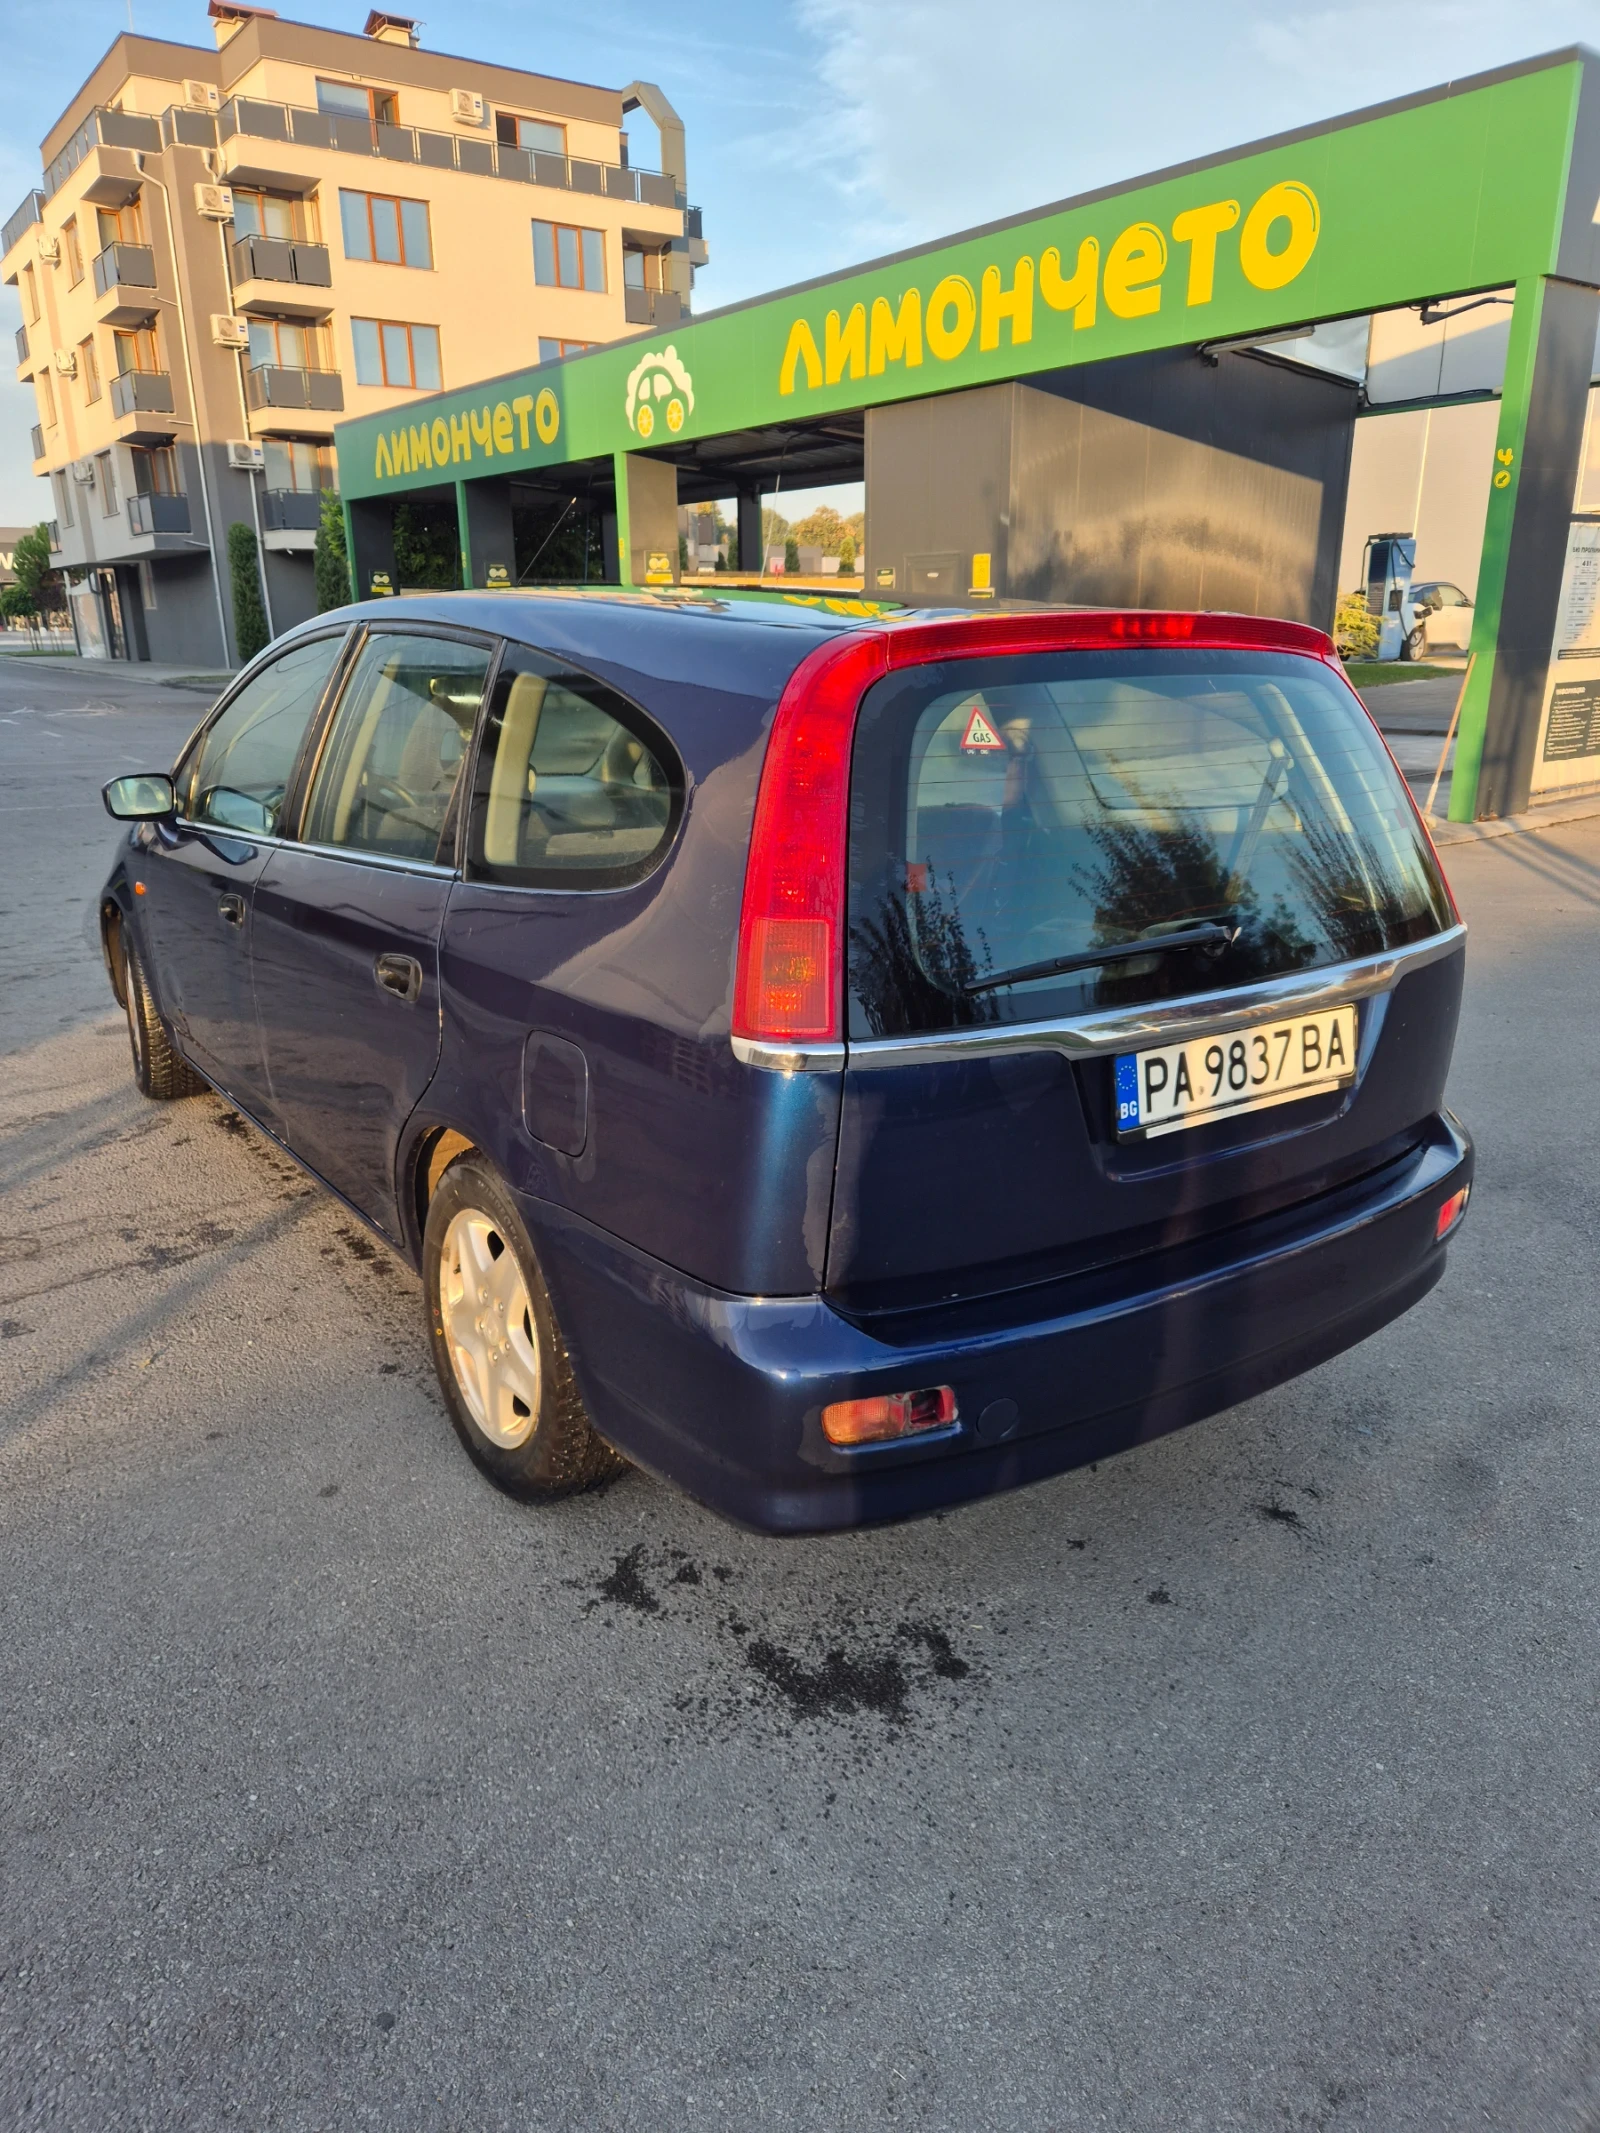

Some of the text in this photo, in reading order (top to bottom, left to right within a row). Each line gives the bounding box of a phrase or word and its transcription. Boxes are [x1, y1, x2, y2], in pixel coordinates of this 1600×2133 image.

[973, 733, 991, 743] GAS
[1144, 1018, 1346, 1114] PA 9837 BA
[1120, 1099, 1138, 1120] BG
